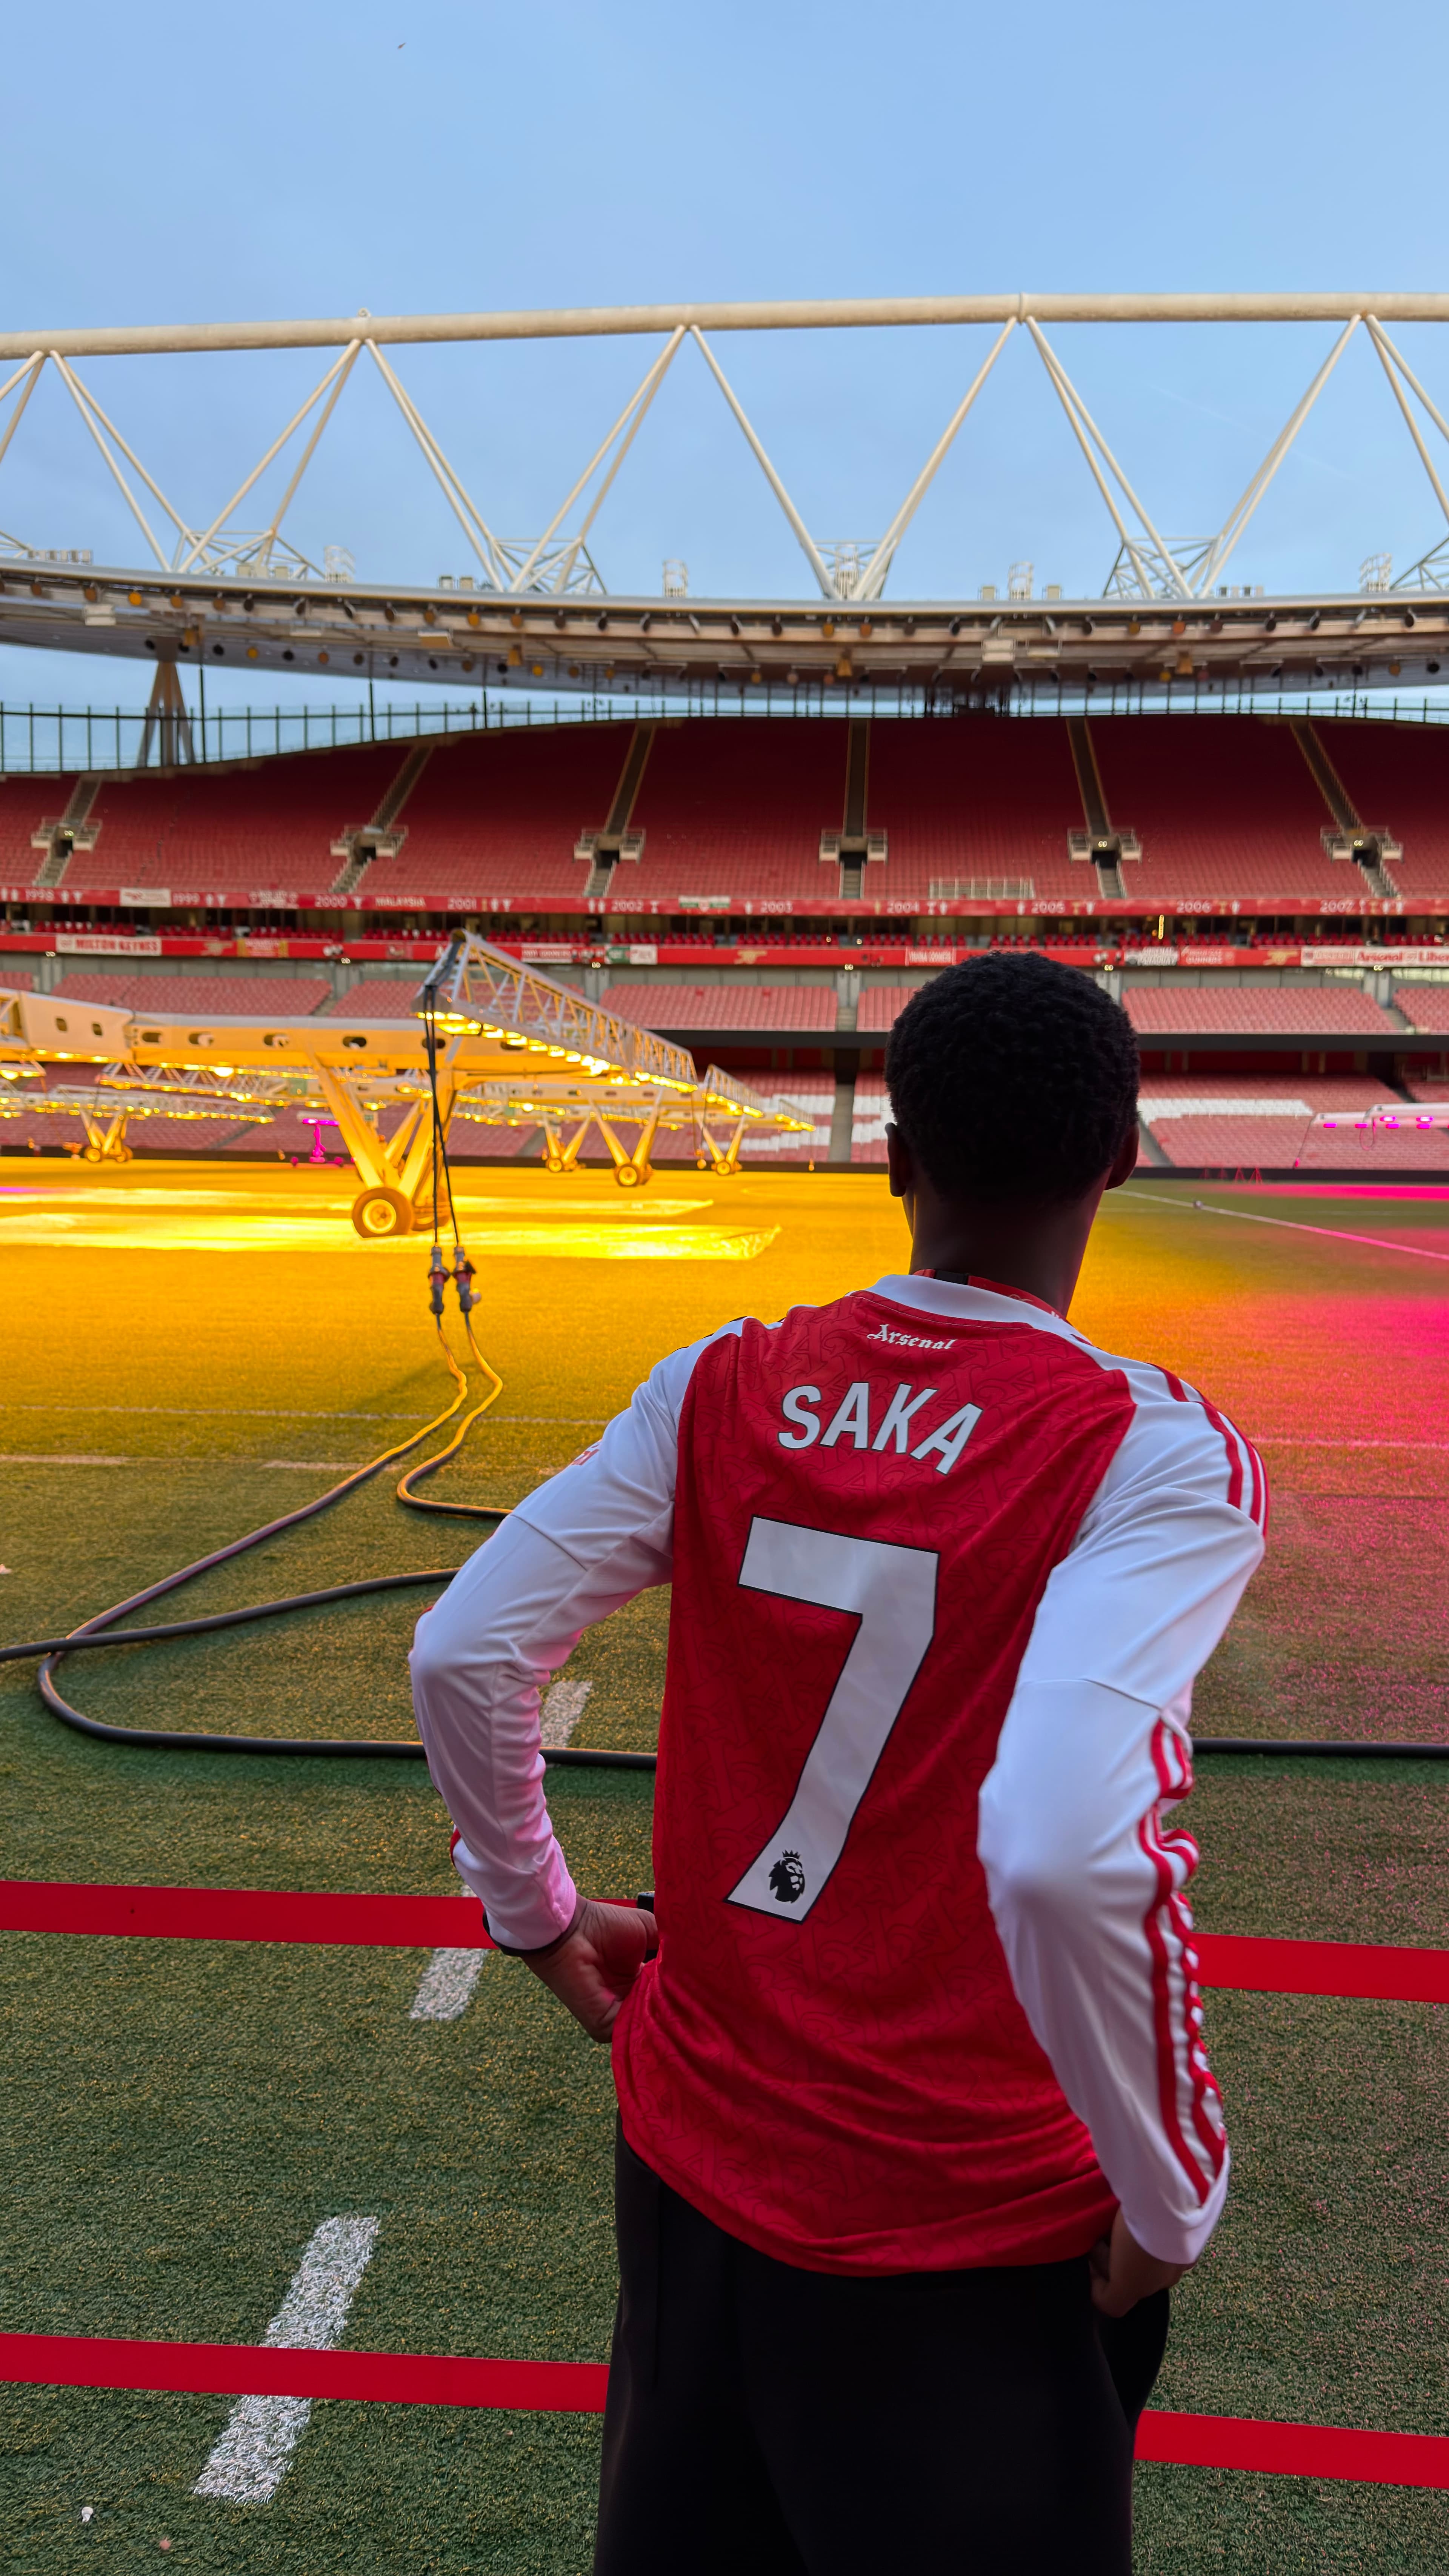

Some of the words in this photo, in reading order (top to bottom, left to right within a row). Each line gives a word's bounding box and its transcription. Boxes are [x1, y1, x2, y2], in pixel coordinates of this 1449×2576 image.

[25, 889, 54, 901] 1998
[173, 892, 200, 905] 1999
[315, 894, 347, 907] 2000
[375, 896, 426, 906] MALAYSIA
[448, 897, 477, 910] 2001
[611, 900, 643, 912] 2002
[761, 901, 793, 913] 2003
[887, 901, 919, 914] 2004
[1177, 900, 1212, 913] 2006
[1320, 900, 1355, 913] 2007
[77, 940, 115, 949] MILTON
[119, 941, 157, 951] KEYNES
[1357, 951, 1403, 961] Arsenal
[866, 1324, 958, 1350] Arsenal
[778, 1382, 983, 1476] SAKA
[723, 1514, 941, 1924] 7
